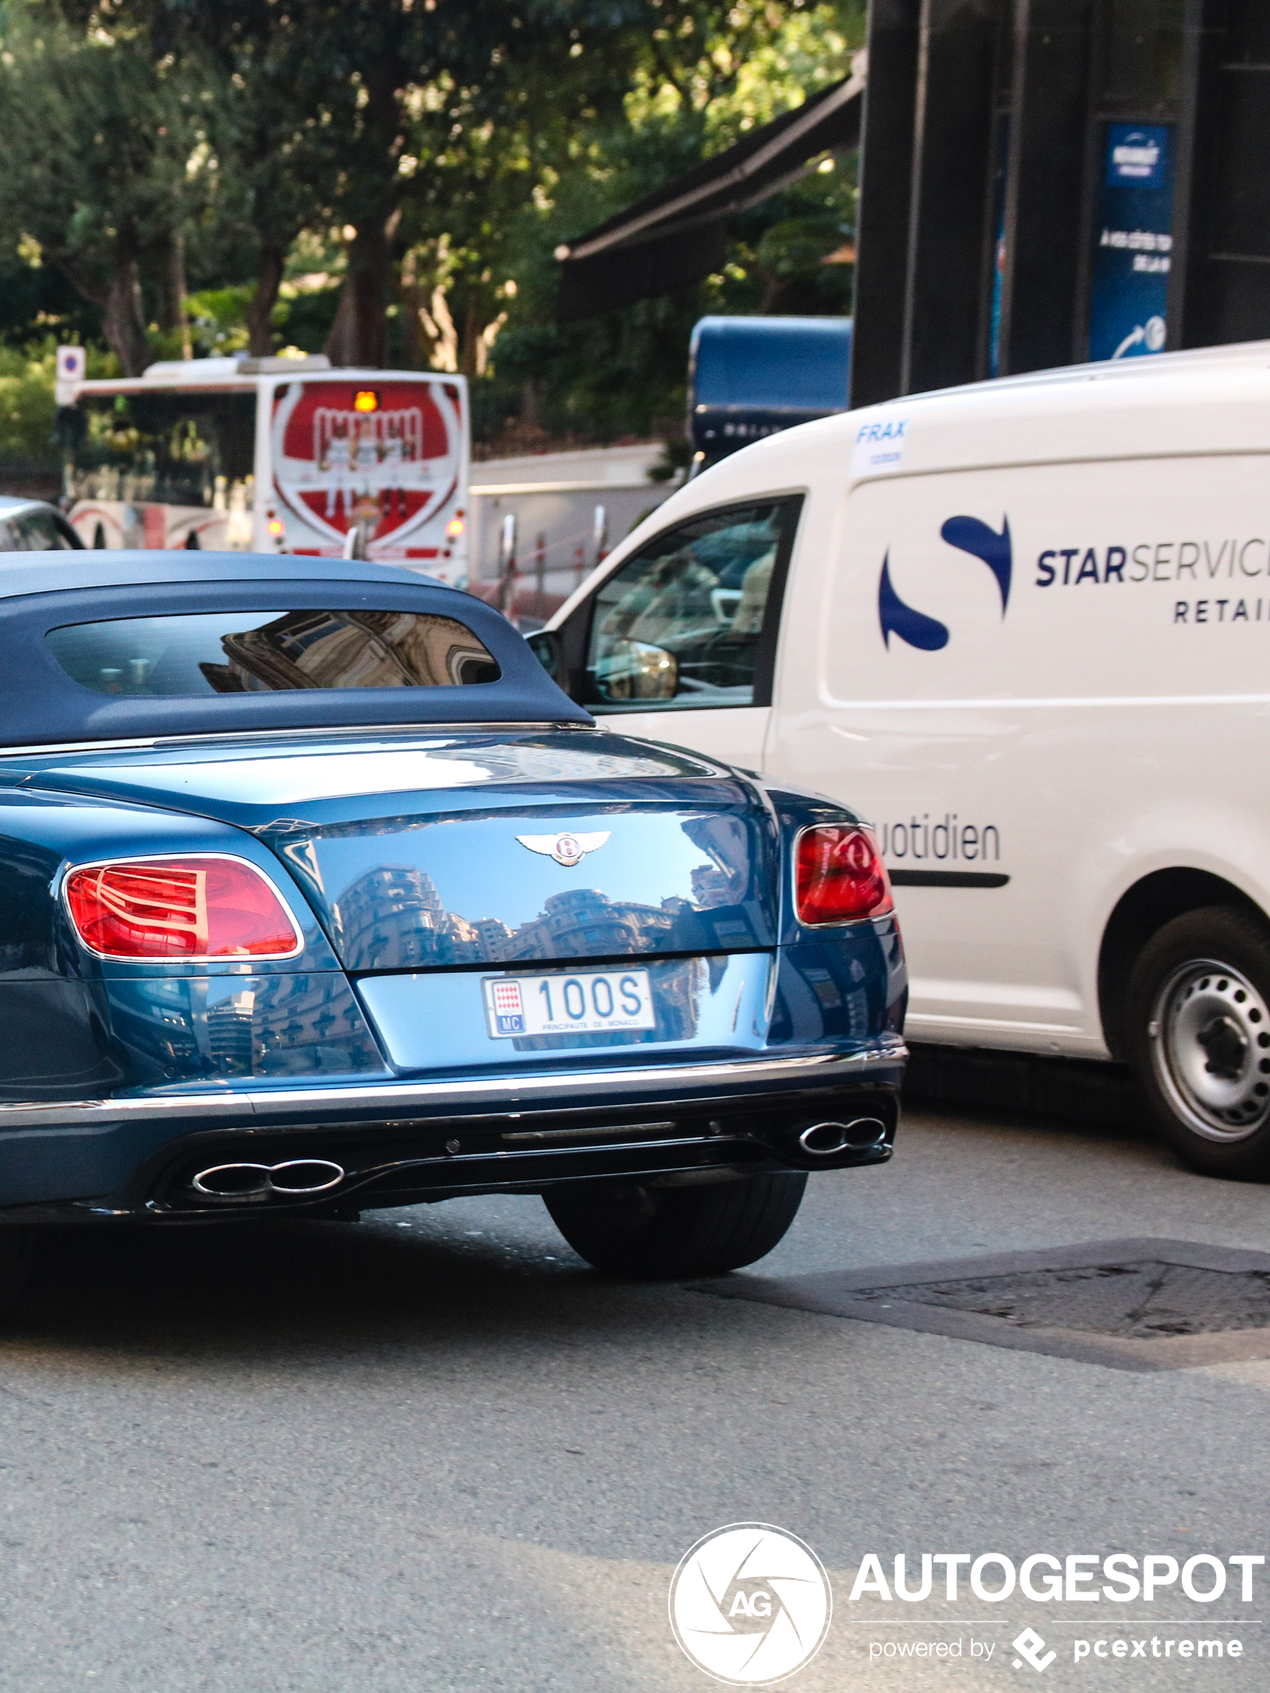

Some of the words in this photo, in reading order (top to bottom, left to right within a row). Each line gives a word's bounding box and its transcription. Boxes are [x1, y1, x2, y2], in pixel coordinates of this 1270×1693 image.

[856, 419, 908, 445] FRAX
[1035, 538, 1270, 588] STARSERVIC
[1174, 597, 1270, 625] RETAI
[539, 975, 642, 1021] 100S
[501, 1016, 520, 1031] MC
[542, 1021, 588, 1031] PRINCIPAUTE
[593, 1020, 603, 1028] DE
[608, 1018, 639, 1028] MONACO
